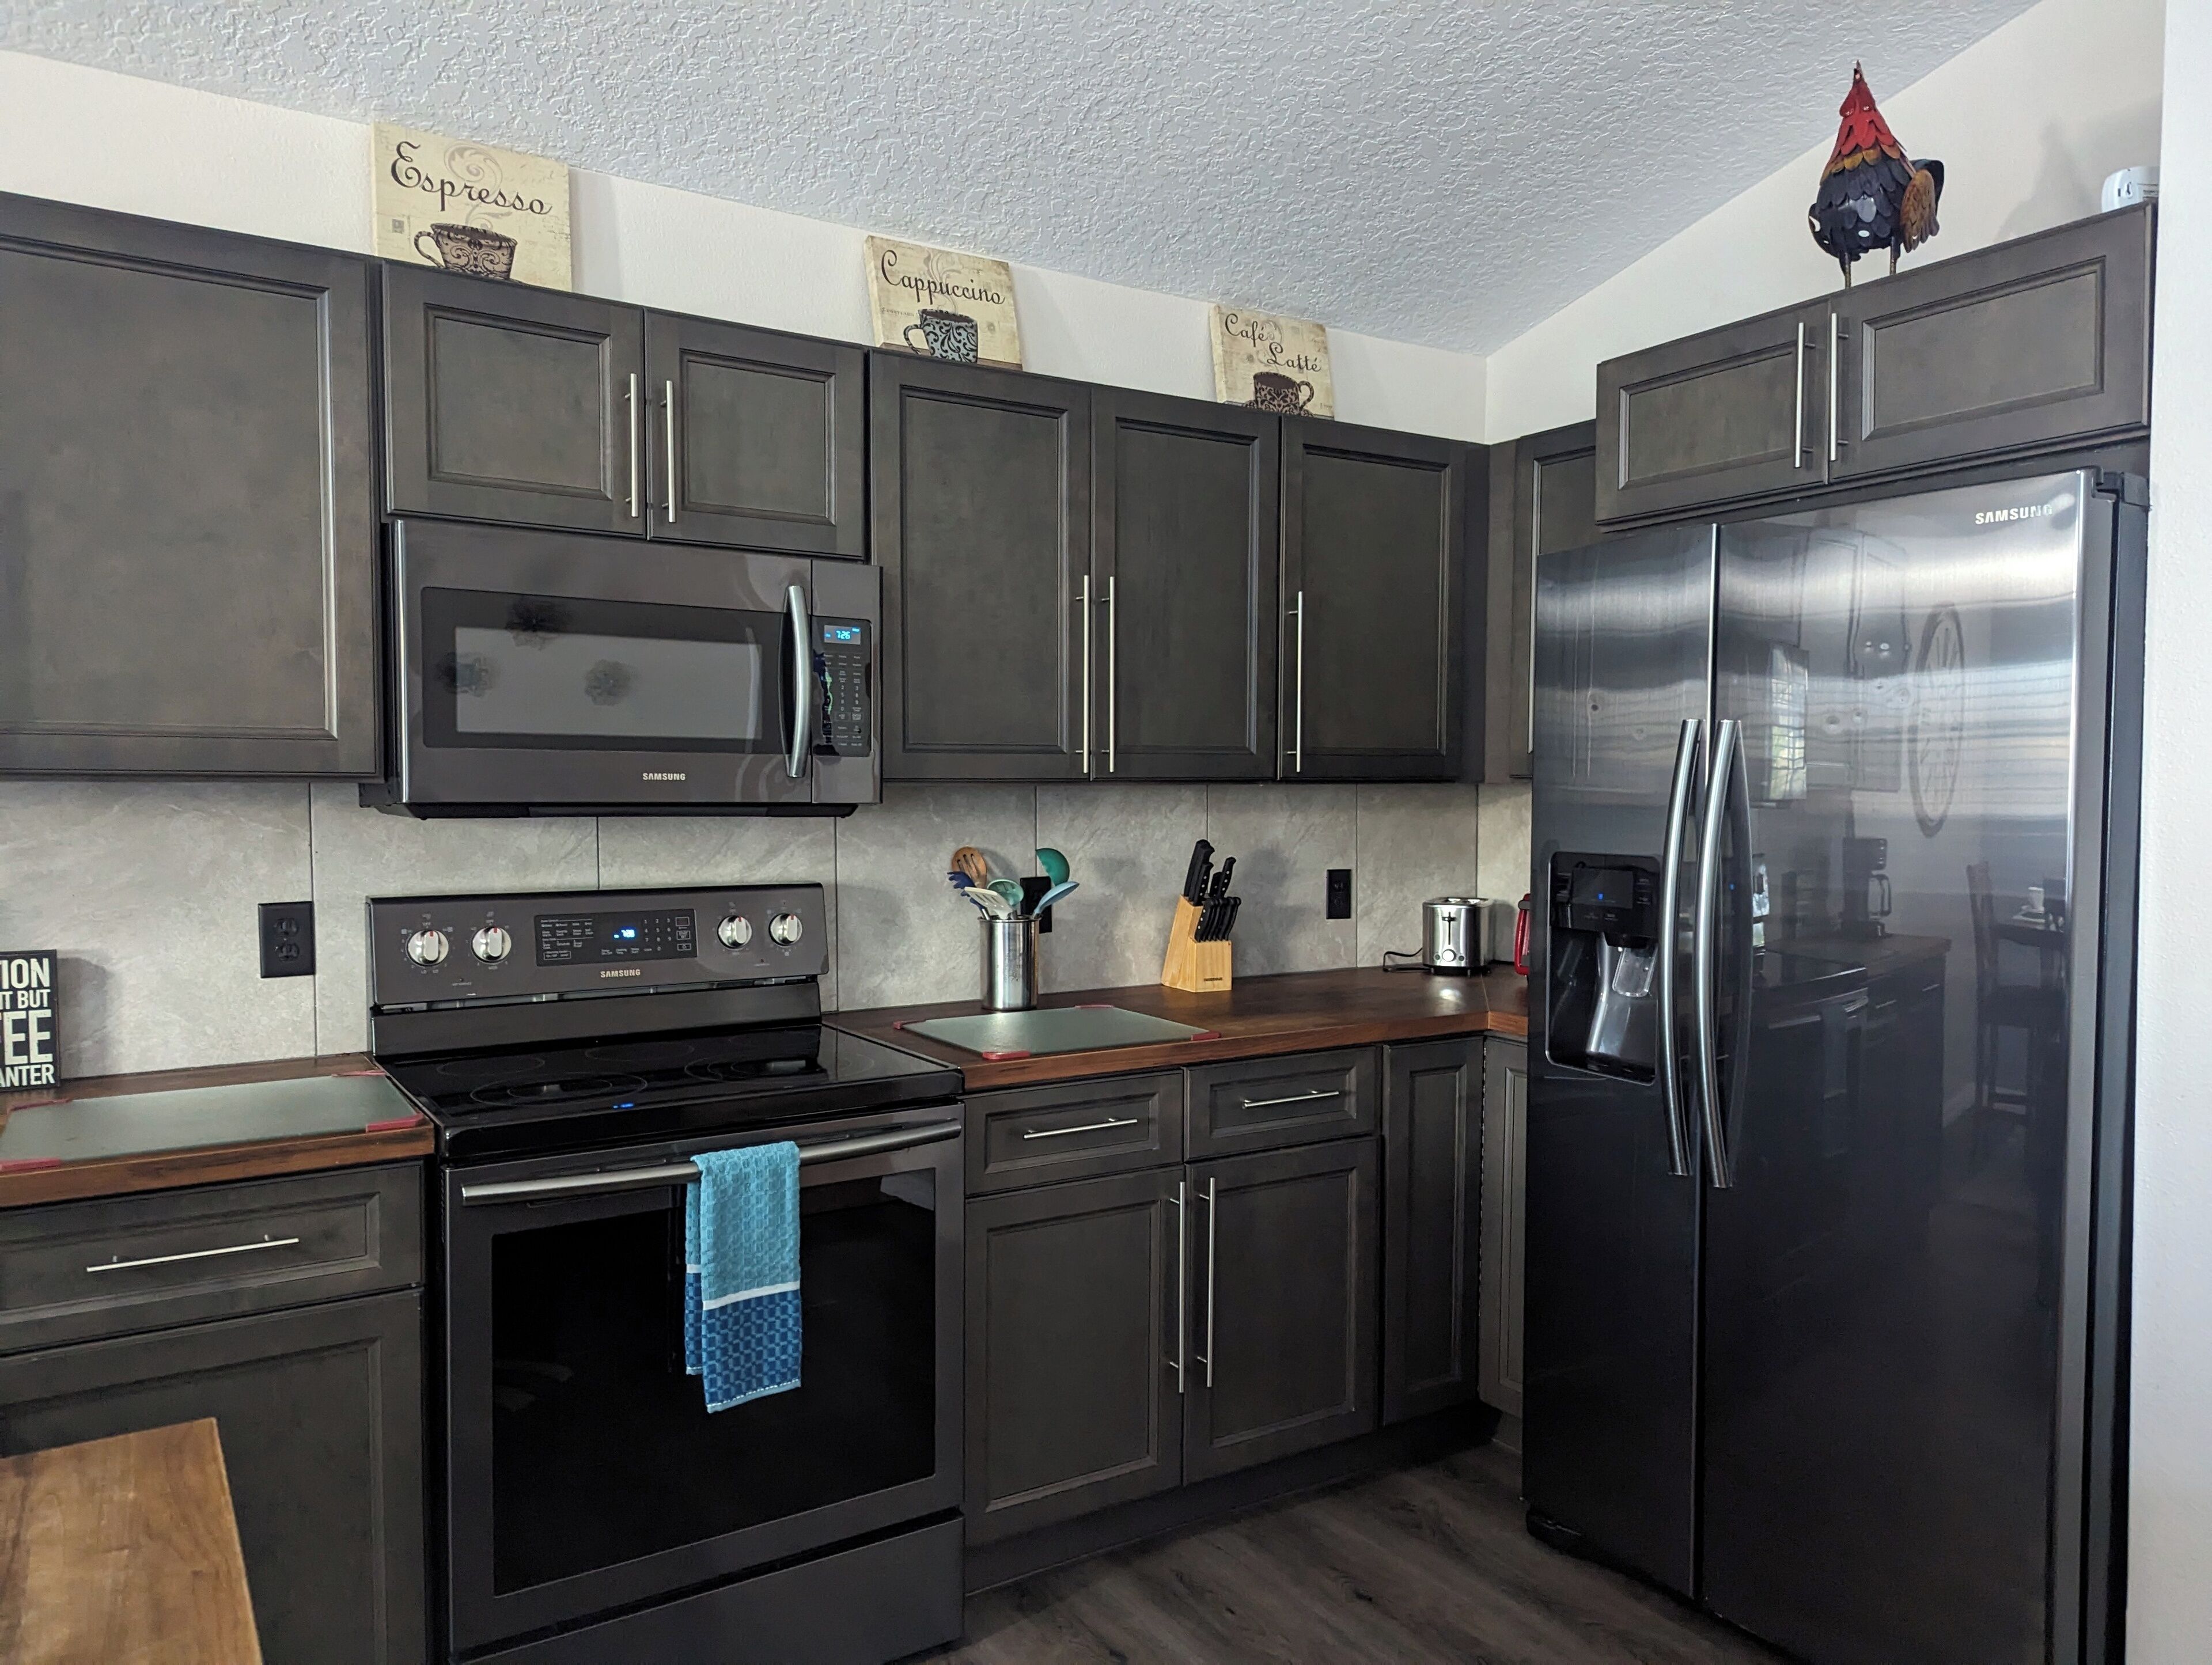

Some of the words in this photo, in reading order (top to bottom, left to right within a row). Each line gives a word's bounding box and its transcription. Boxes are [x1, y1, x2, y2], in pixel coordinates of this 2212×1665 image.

[391, 141, 553, 215] Espresso
[881, 249, 1005, 305] Cappuccino
[1225, 313, 1268, 348] Café
[1267, 342, 1322, 372] Latté
[1975, 504, 2053, 525] SAMSUNG
[642, 772, 685, 780] SAMSUNG
[0, 958, 50, 989] ION
[600, 969, 641, 978] SAMSUNG
[17, 989, 51, 1008] BUT
[0, 1009, 53, 1065] EE
